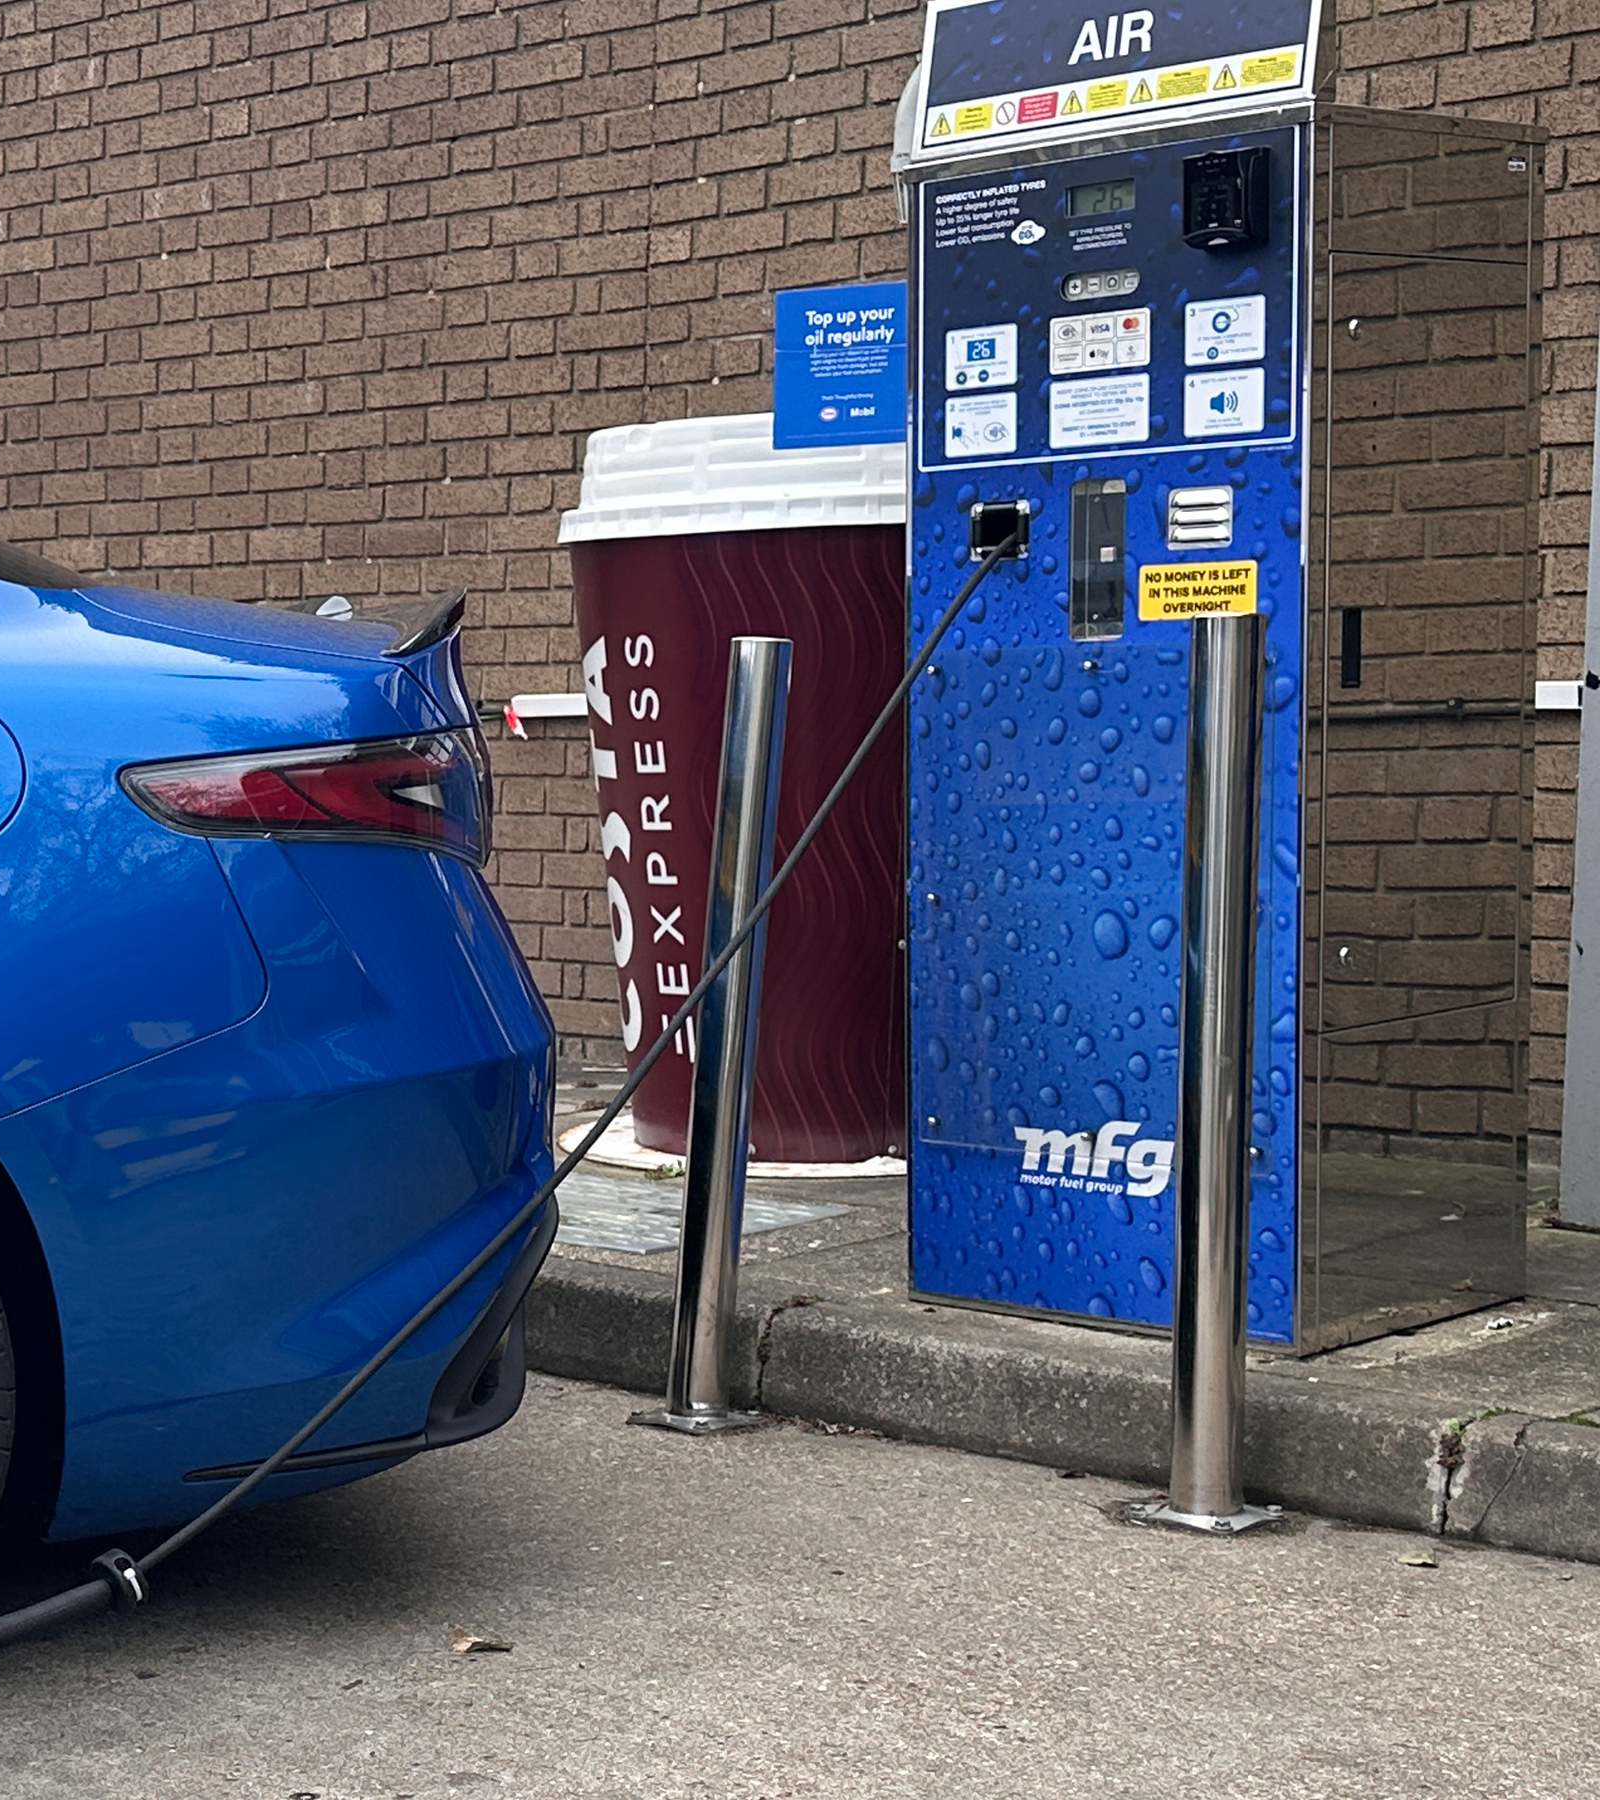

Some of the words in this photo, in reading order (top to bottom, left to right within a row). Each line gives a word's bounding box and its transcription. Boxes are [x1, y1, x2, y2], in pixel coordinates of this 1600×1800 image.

[1067, 9, 1154, 66] AIR
[935, 190, 982, 205] CORRECTLY
[982, 184, 1020, 198] INFLATED
[1020, 179, 1046, 192] TYRES
[1092, 184, 1123, 213] 26
[936, 207, 942, 215] A
[988, 198, 997, 207] of
[935, 227, 956, 237] Lower
[970, 219, 1015, 232] consumption
[936, 218, 947, 227] Up
[935, 238, 956, 248] Lower
[805, 310, 833, 328] Top
[836, 310, 856, 326] up
[859, 307, 895, 325] your
[1190, 308, 1196, 317] 3
[804, 329, 823, 346] oil
[827, 324, 895, 347] regularly
[1090, 324, 1110, 334] VISA
[972, 341, 991, 359] 26
[1188, 379, 1195, 389] 4
[850, 406, 876, 418] Mobil
[1145, 573, 1161, 584] NO
[1164, 570, 1206, 583] MONEY
[1209, 569, 1220, 581] IS
[1222, 568, 1251, 580] LEFT
[1148, 588, 1160, 599] IN
[1163, 586, 1189, 599] THIS
[1192, 584, 1246, 597] MACHINE
[1163, 600, 1231, 614] OVERNIGHT
[624, 634, 690, 995] EXPRESS
[1013, 1119, 1175, 1197] mfg
[1020, 1173, 1058, 1187] motor
[1059, 1175, 1084, 1190] fuel
[1085, 1180, 1124, 1196] group
